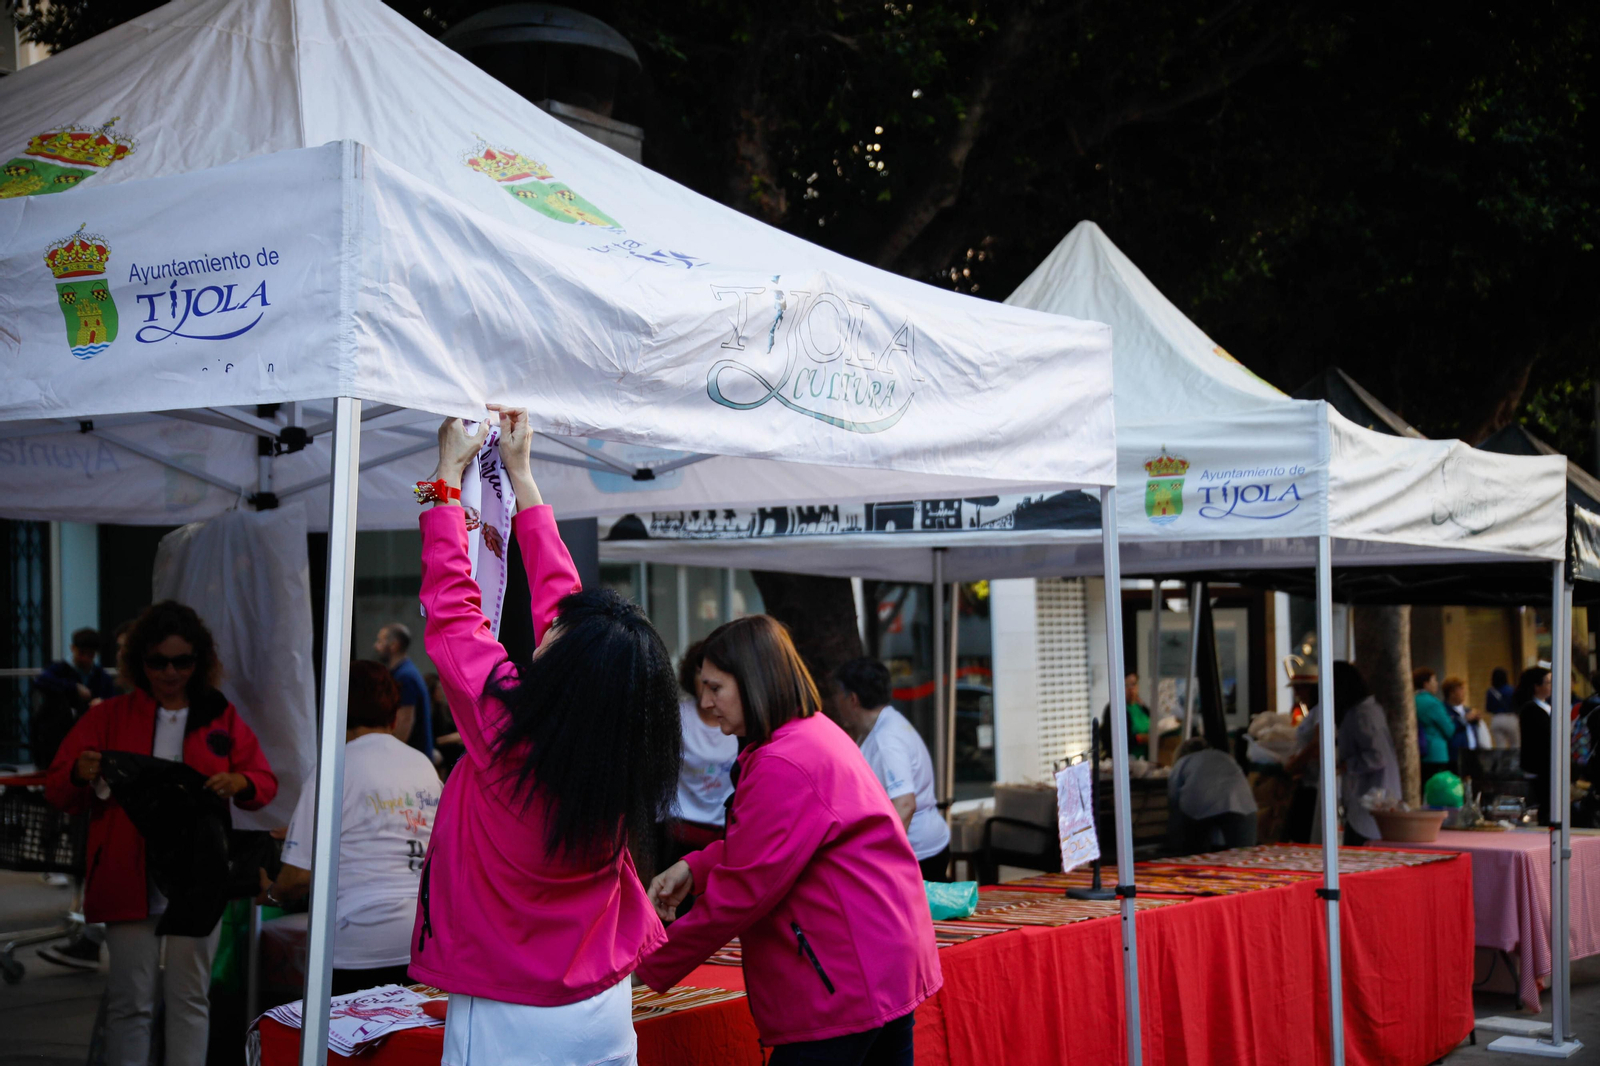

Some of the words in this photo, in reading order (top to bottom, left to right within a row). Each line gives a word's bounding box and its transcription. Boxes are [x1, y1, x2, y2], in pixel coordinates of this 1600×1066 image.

[128, 251, 251, 286] Ayuntamiento
[256, 247, 280, 267] de
[792, 366, 897, 414] CULTURA
[1200, 466, 1286, 482] Ayuntamiento
[1288, 464, 1306, 476] de
